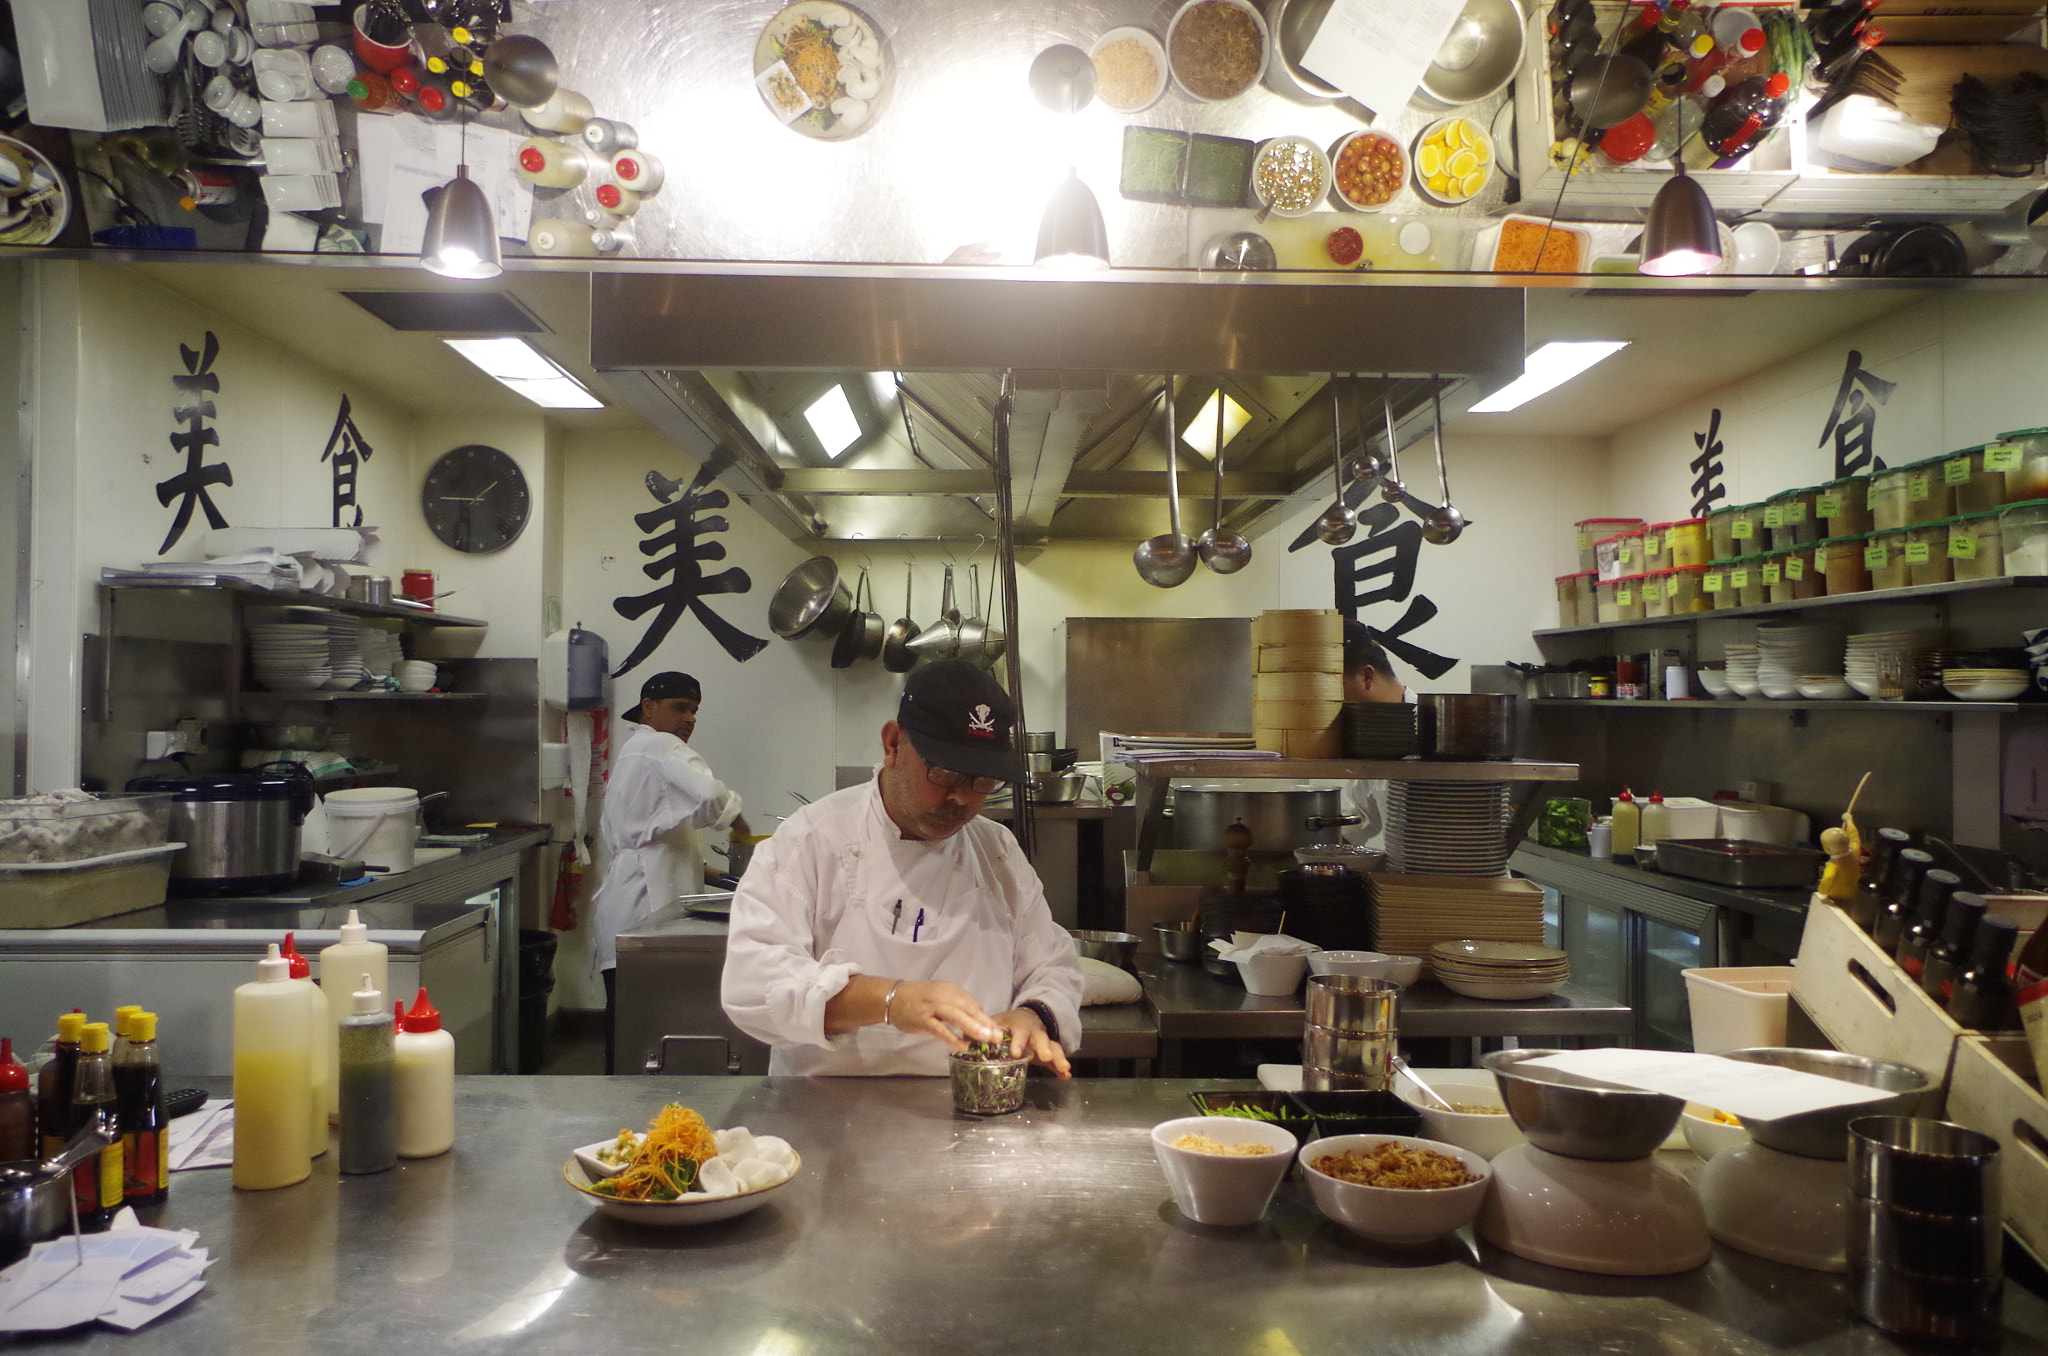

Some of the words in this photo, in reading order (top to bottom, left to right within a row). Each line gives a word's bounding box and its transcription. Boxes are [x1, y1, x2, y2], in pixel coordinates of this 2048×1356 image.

[156, 331, 233, 555] 美
[609, 440, 770, 679] 美
[1287, 461, 1473, 680] 食
